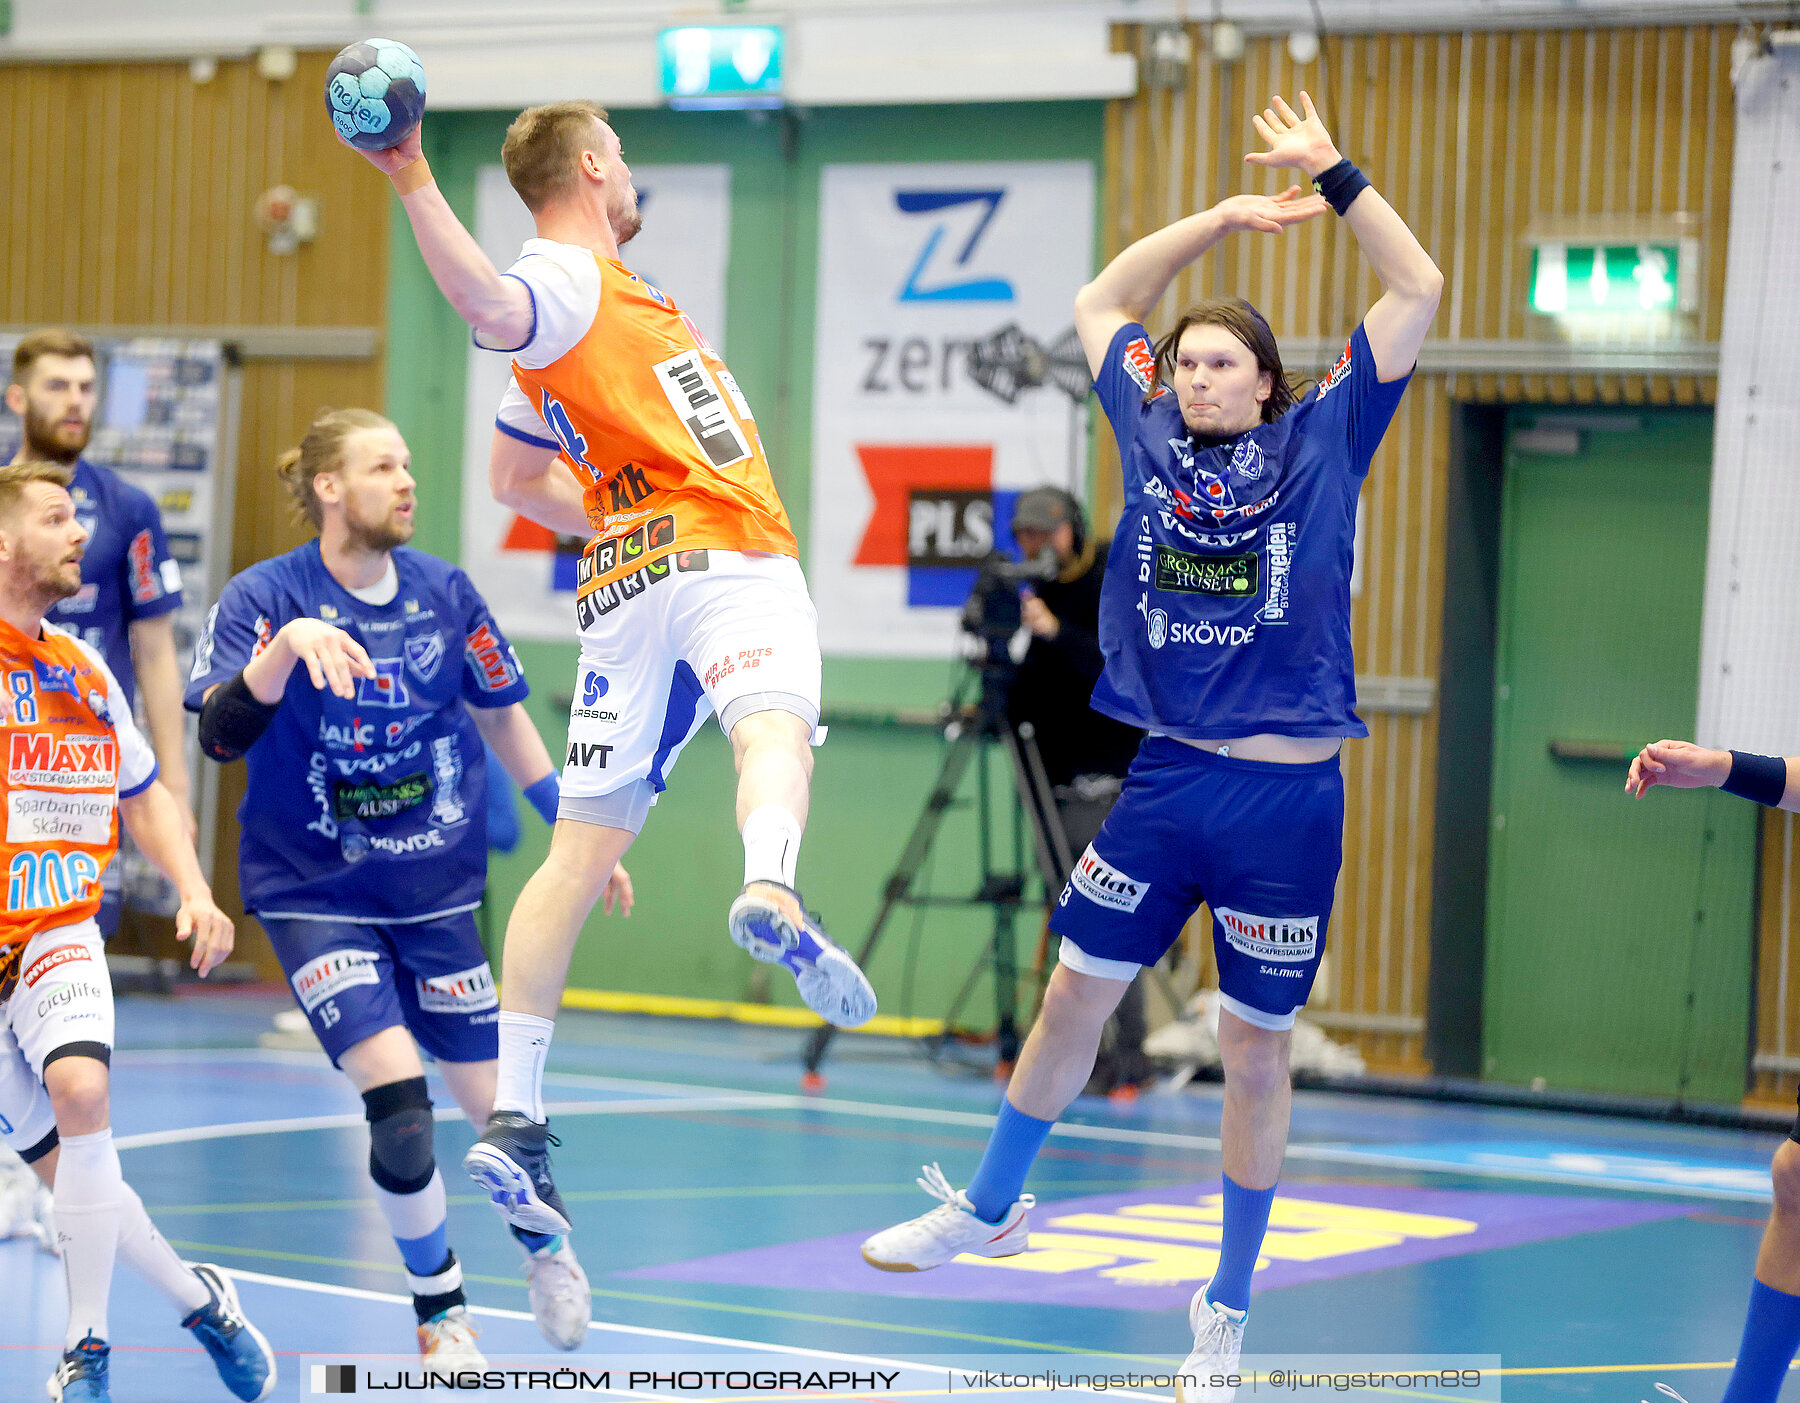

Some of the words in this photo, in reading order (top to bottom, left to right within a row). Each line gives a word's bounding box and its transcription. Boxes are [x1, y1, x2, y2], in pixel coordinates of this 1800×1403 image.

[864, 336, 978, 393] zer
[911, 500, 994, 557] PLS
[1287, 522, 1296, 537] AB
[1137, 515, 1153, 583] bilia
[1160, 553, 1247, 578] GRÖNSAKS
[1176, 571, 1234, 591] HUSET
[1170, 620, 1256, 646] SKÖVDE
[467, 625, 509, 688] MAXI
[738, 647, 773, 660] PUTS
[711, 664, 735, 689] BYGG
[742, 658, 760, 669] AB
[11, 735, 113, 772] MAXI
[29, 772, 113, 785] STORMARKNAD
[15, 797, 110, 817] Sparbanken
[33, 816, 82, 836] Skåne
[1224, 914, 1314, 943] mattias
[26, 947, 90, 984] INVECTUS
[1260, 965, 1305, 978] SALMING
[37, 982, 100, 1018] Citylife
[318, 999, 341, 1030] 15
